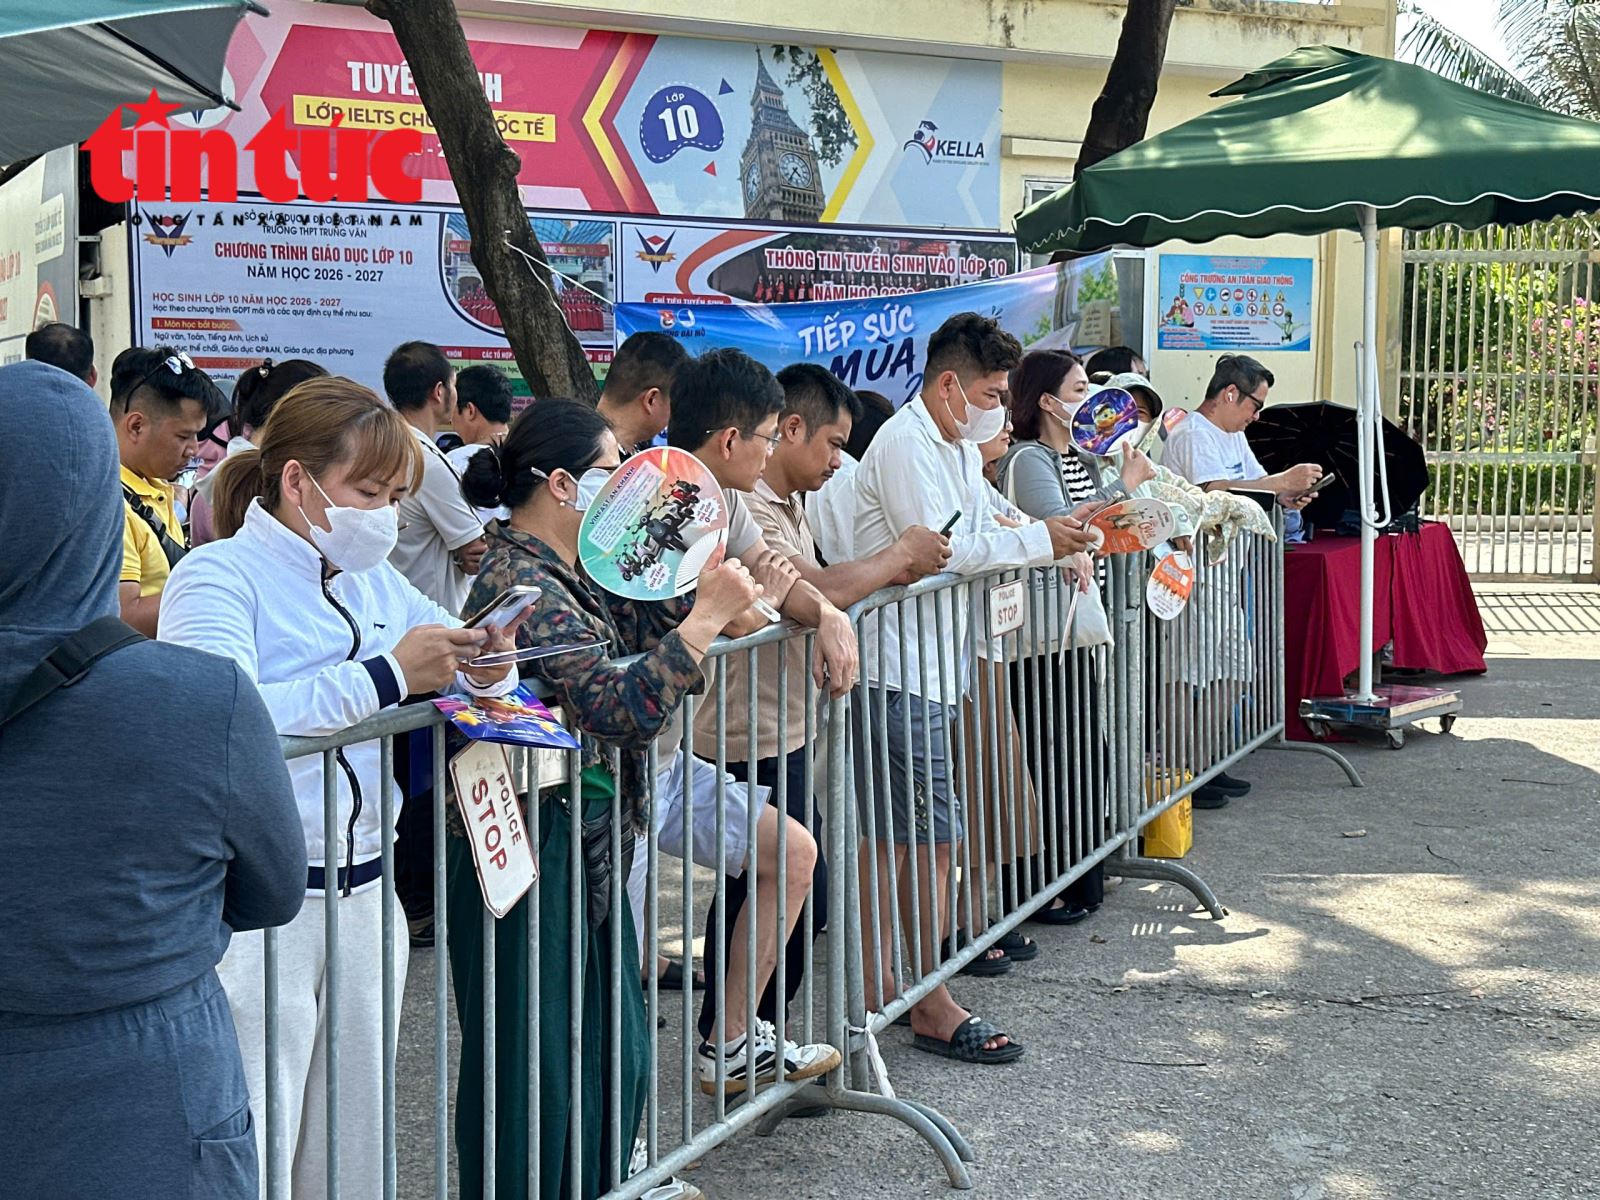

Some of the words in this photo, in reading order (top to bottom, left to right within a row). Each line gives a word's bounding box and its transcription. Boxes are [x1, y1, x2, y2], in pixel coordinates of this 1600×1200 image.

[665, 92, 685, 103] LỚP
[306, 102, 343, 120] LỚP
[348, 107, 395, 125] IELTS
[399, 111, 434, 127] CHU
[495, 114, 520, 134] ỐC
[523, 117, 546, 136] TẾ
[658, 104, 699, 141] 10
[935, 140, 984, 158] KELLA
[299, 226, 318, 237] THPT
[320, 227, 347, 237] TRUNG
[214, 242, 267, 259] CHƯƠNG
[270, 242, 308, 261] TRÌNH
[311, 243, 341, 263] GIÁO
[344, 249, 369, 267] DỤC
[372, 246, 395, 265] LỚP
[399, 250, 413, 265] 10
[765, 245, 814, 270] THÔNG
[817, 251, 842, 271] TIN
[845, 247, 889, 273] TUYỂN
[892, 254, 926, 275] SINH
[928, 251, 956, 276] VÀO
[959, 253, 987, 278] LỚP
[989, 258, 1007, 277] 10
[247, 263, 277, 279] NĂM
[281, 266, 311, 282] HỌC
[314, 268, 343, 281] 2026
[355, 269, 384, 282] 2027
[152, 292, 175, 303] HỌC
[177, 293, 202, 303] SINH
[204, 291, 225, 303] LỚP
[228, 295, 239, 304] 10
[241, 294, 264, 304] NĂM
[266, 296, 288, 306] HỌC
[290, 297, 312, 306] 2026
[320, 298, 341, 307] 2027
[813, 281, 846, 301] NĂM
[798, 311, 857, 358] TIẾP
[863, 303, 915, 344] SỨC
[830, 336, 916, 387] MÙA
[998, 604, 1018, 625] STOP
[496, 773, 522, 847] POLICE
[471, 777, 508, 871] STOP
